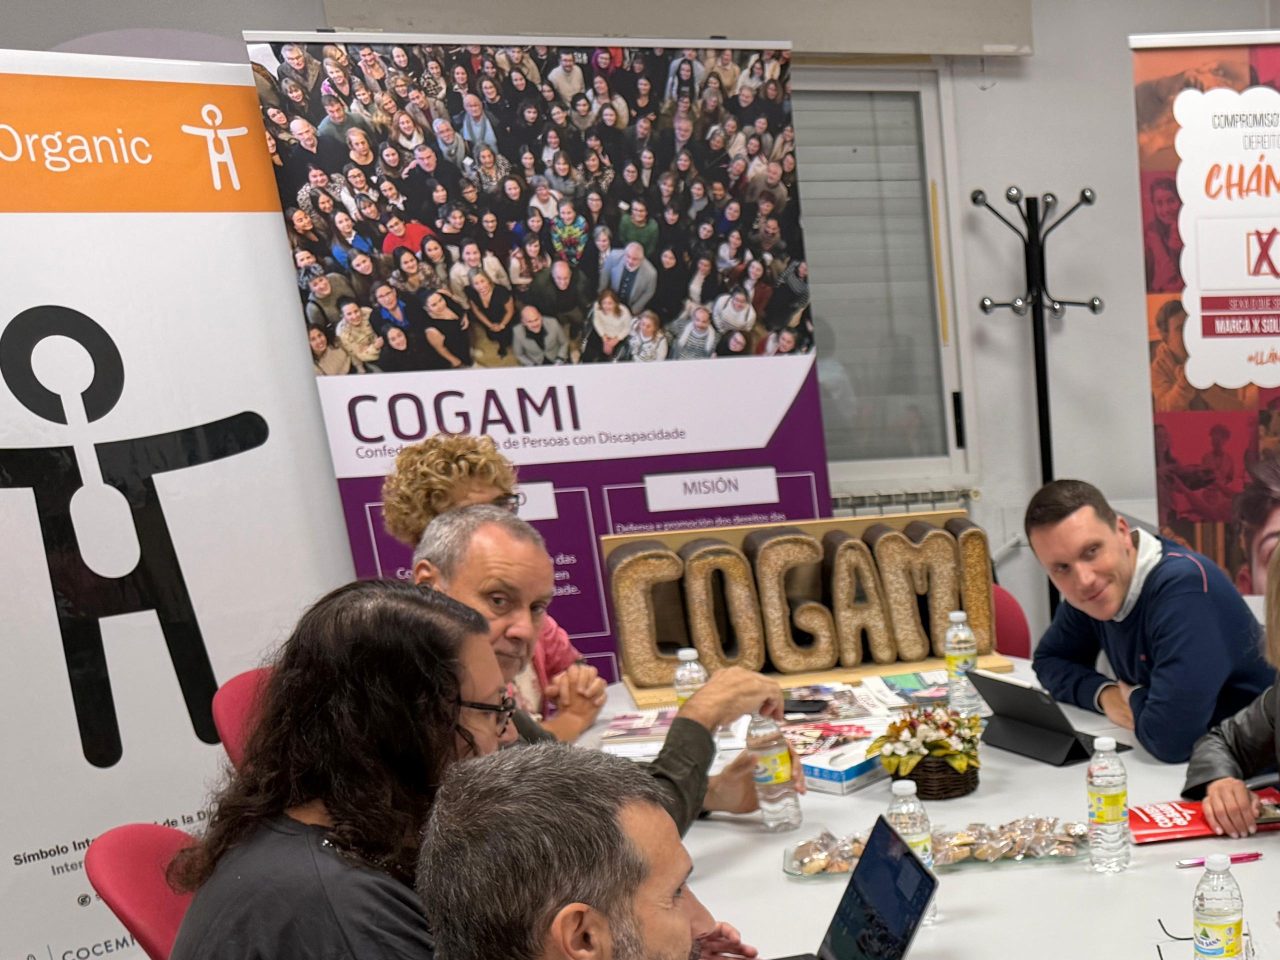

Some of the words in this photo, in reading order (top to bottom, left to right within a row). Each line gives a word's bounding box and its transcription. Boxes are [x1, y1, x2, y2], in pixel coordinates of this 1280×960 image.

[0, 124, 153, 173] Organic
[1215, 316, 1250, 334] MARCA
[1251, 316, 1261, 333] X
[347, 385, 581, 443] COGAMI
[503, 436, 519, 450] de
[522, 433, 570, 449] Persoas
[572, 434, 595, 446] con
[599, 428, 687, 446] Discapacidade
[683, 477, 740, 496] MISIÓN
[555, 553, 577, 565] das
[607, 518, 994, 688] COGAMI
[182, 812, 194, 825] la
[13, 844, 69, 866] Símbolo
